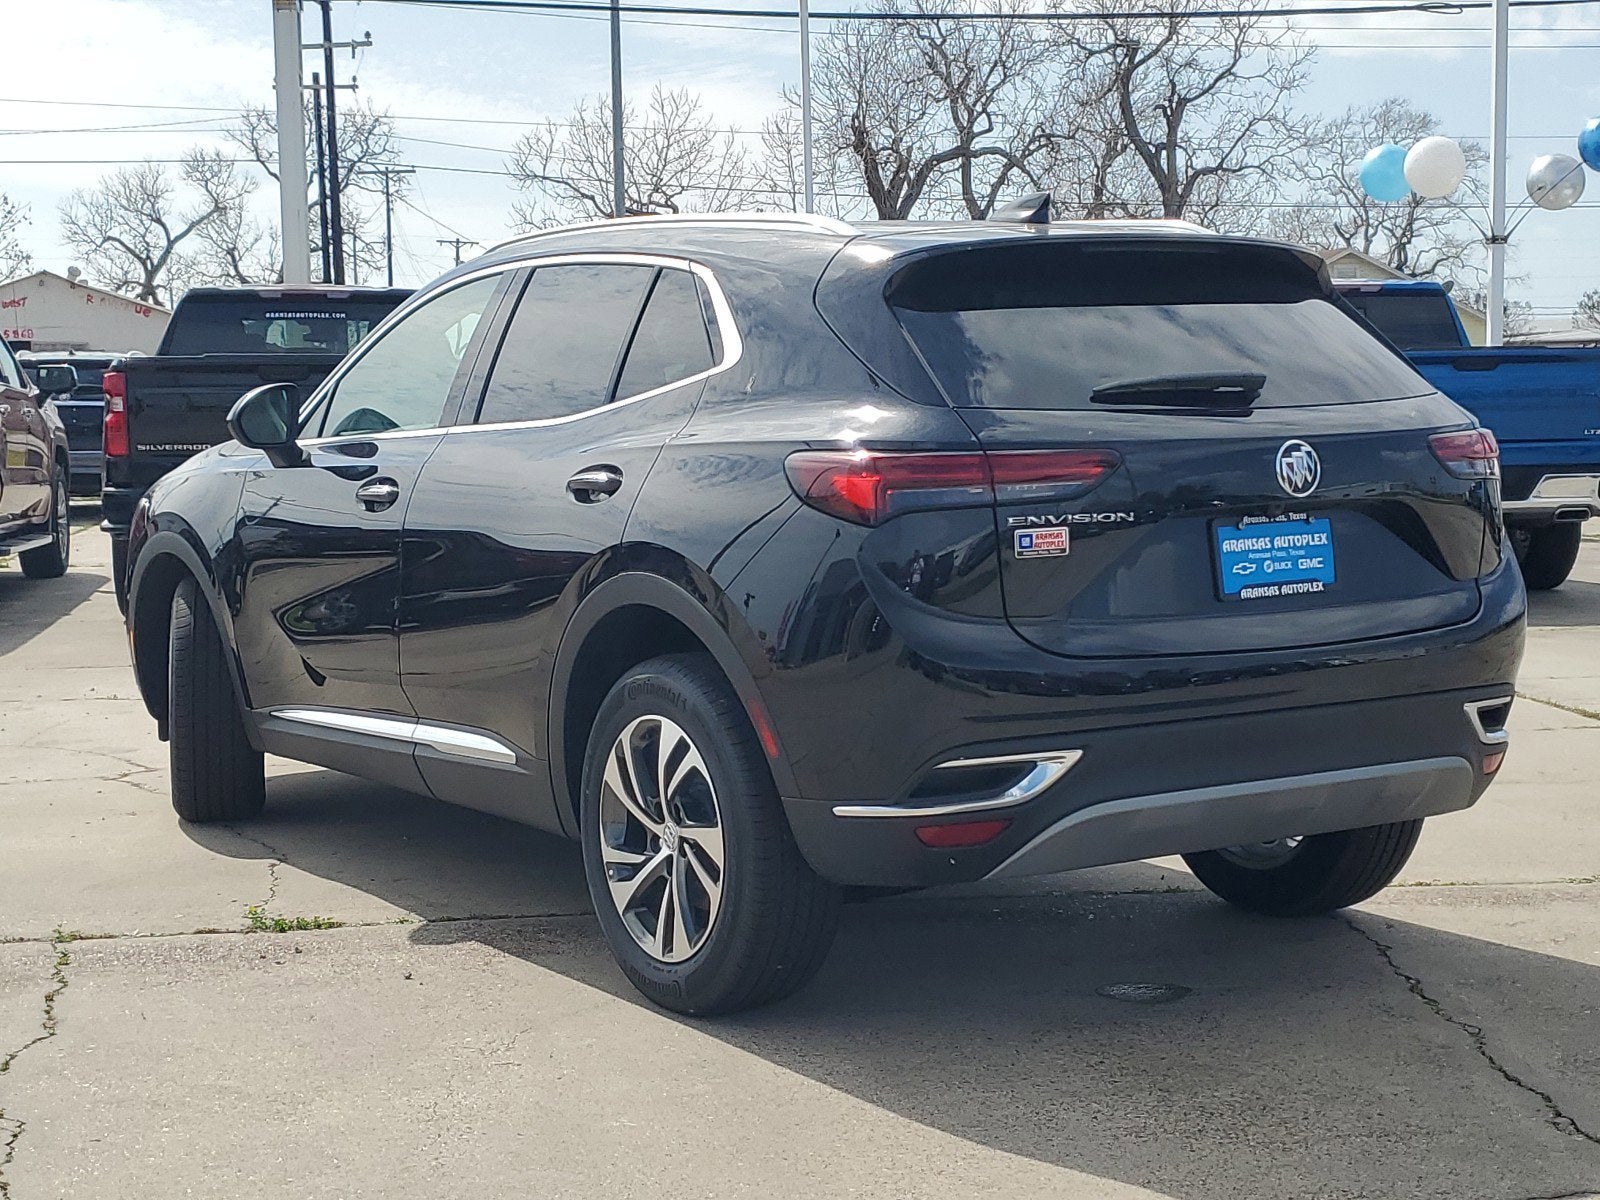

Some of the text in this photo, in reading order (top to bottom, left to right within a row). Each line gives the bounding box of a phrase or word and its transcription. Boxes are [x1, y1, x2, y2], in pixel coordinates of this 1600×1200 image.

[1007, 511, 1135, 527] ENVISION
[1035, 532, 1064, 540] ARANSAS
[1222, 533, 1329, 553] ARANSAS AUTOPLEX
[1033, 540, 1065, 549] AUTOPLEX
[1298, 557, 1324, 569] GMC
[1240, 581, 1325, 599] ARANSAS AUTOPLEX
